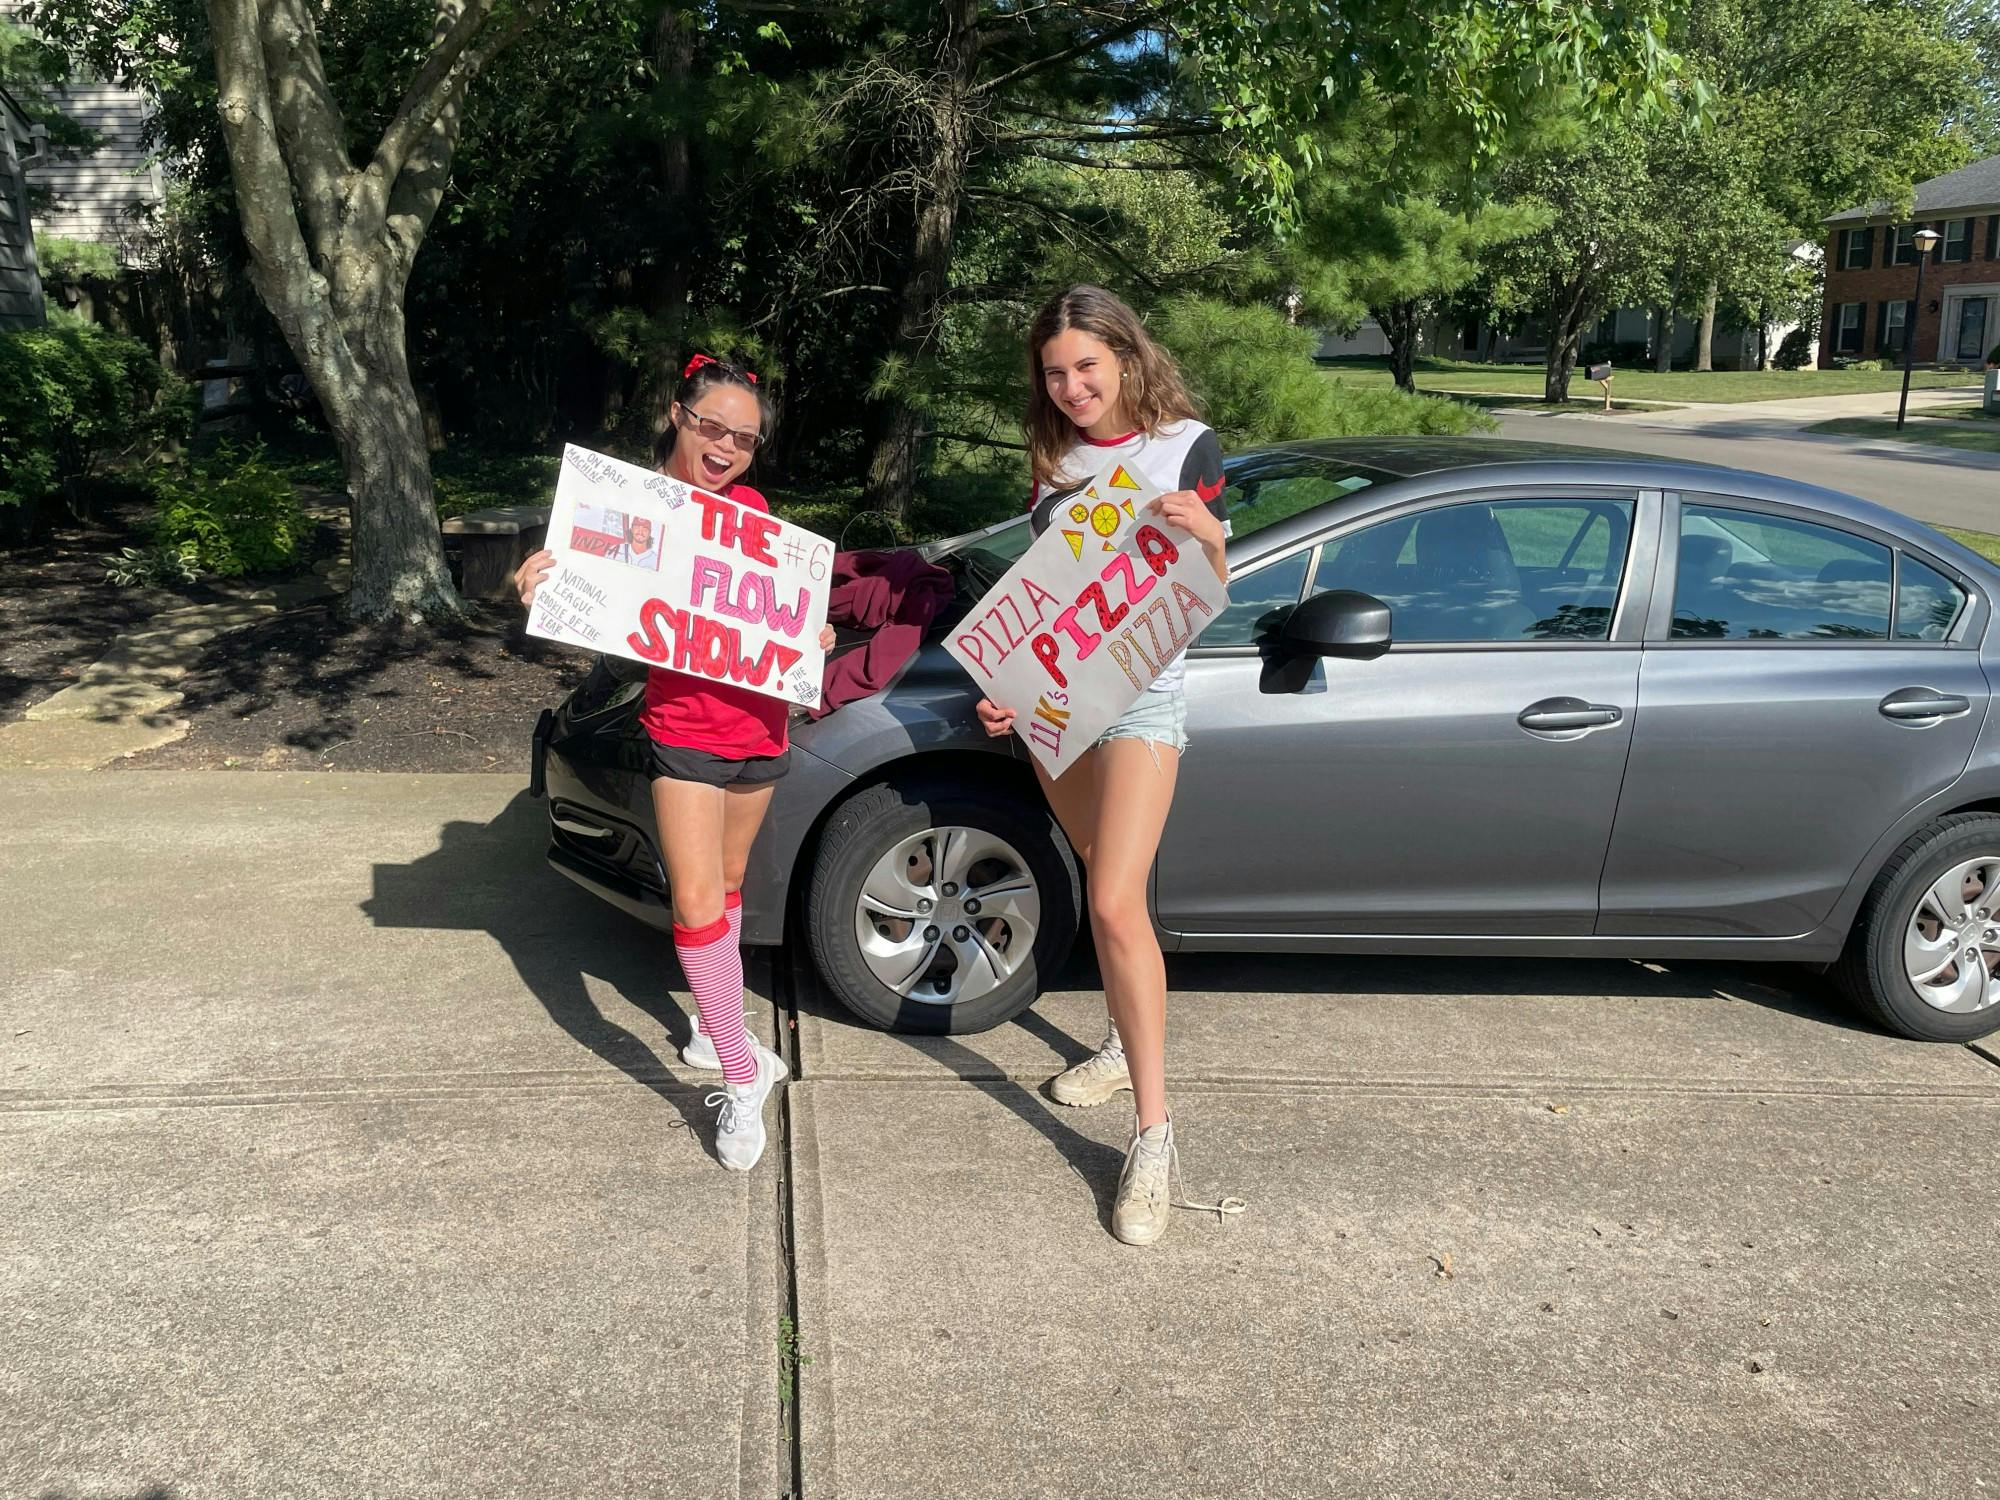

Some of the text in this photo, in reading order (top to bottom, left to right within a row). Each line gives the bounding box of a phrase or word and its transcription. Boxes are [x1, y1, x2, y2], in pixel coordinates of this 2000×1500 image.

[566, 448, 606, 483] MACHINE
[587, 453, 628, 489] ON-BASE
[571, 533, 621, 560] INDIA
[690, 490, 782, 568] THE
[783, 535, 830, 582] #6
[553, 582, 594, 617] LEAGUE
[560, 568, 608, 608] NATIONAL
[690, 555, 811, 638] FLOW
[1030, 523, 1180, 689] PIZZA
[538, 590, 601, 641] ROOKIE OF THE
[540, 612, 564, 635] YEAR
[957, 577, 1061, 679] PIZZA
[1107, 581, 1213, 691] PIZZA
[627, 597, 804, 691] SHOW!
